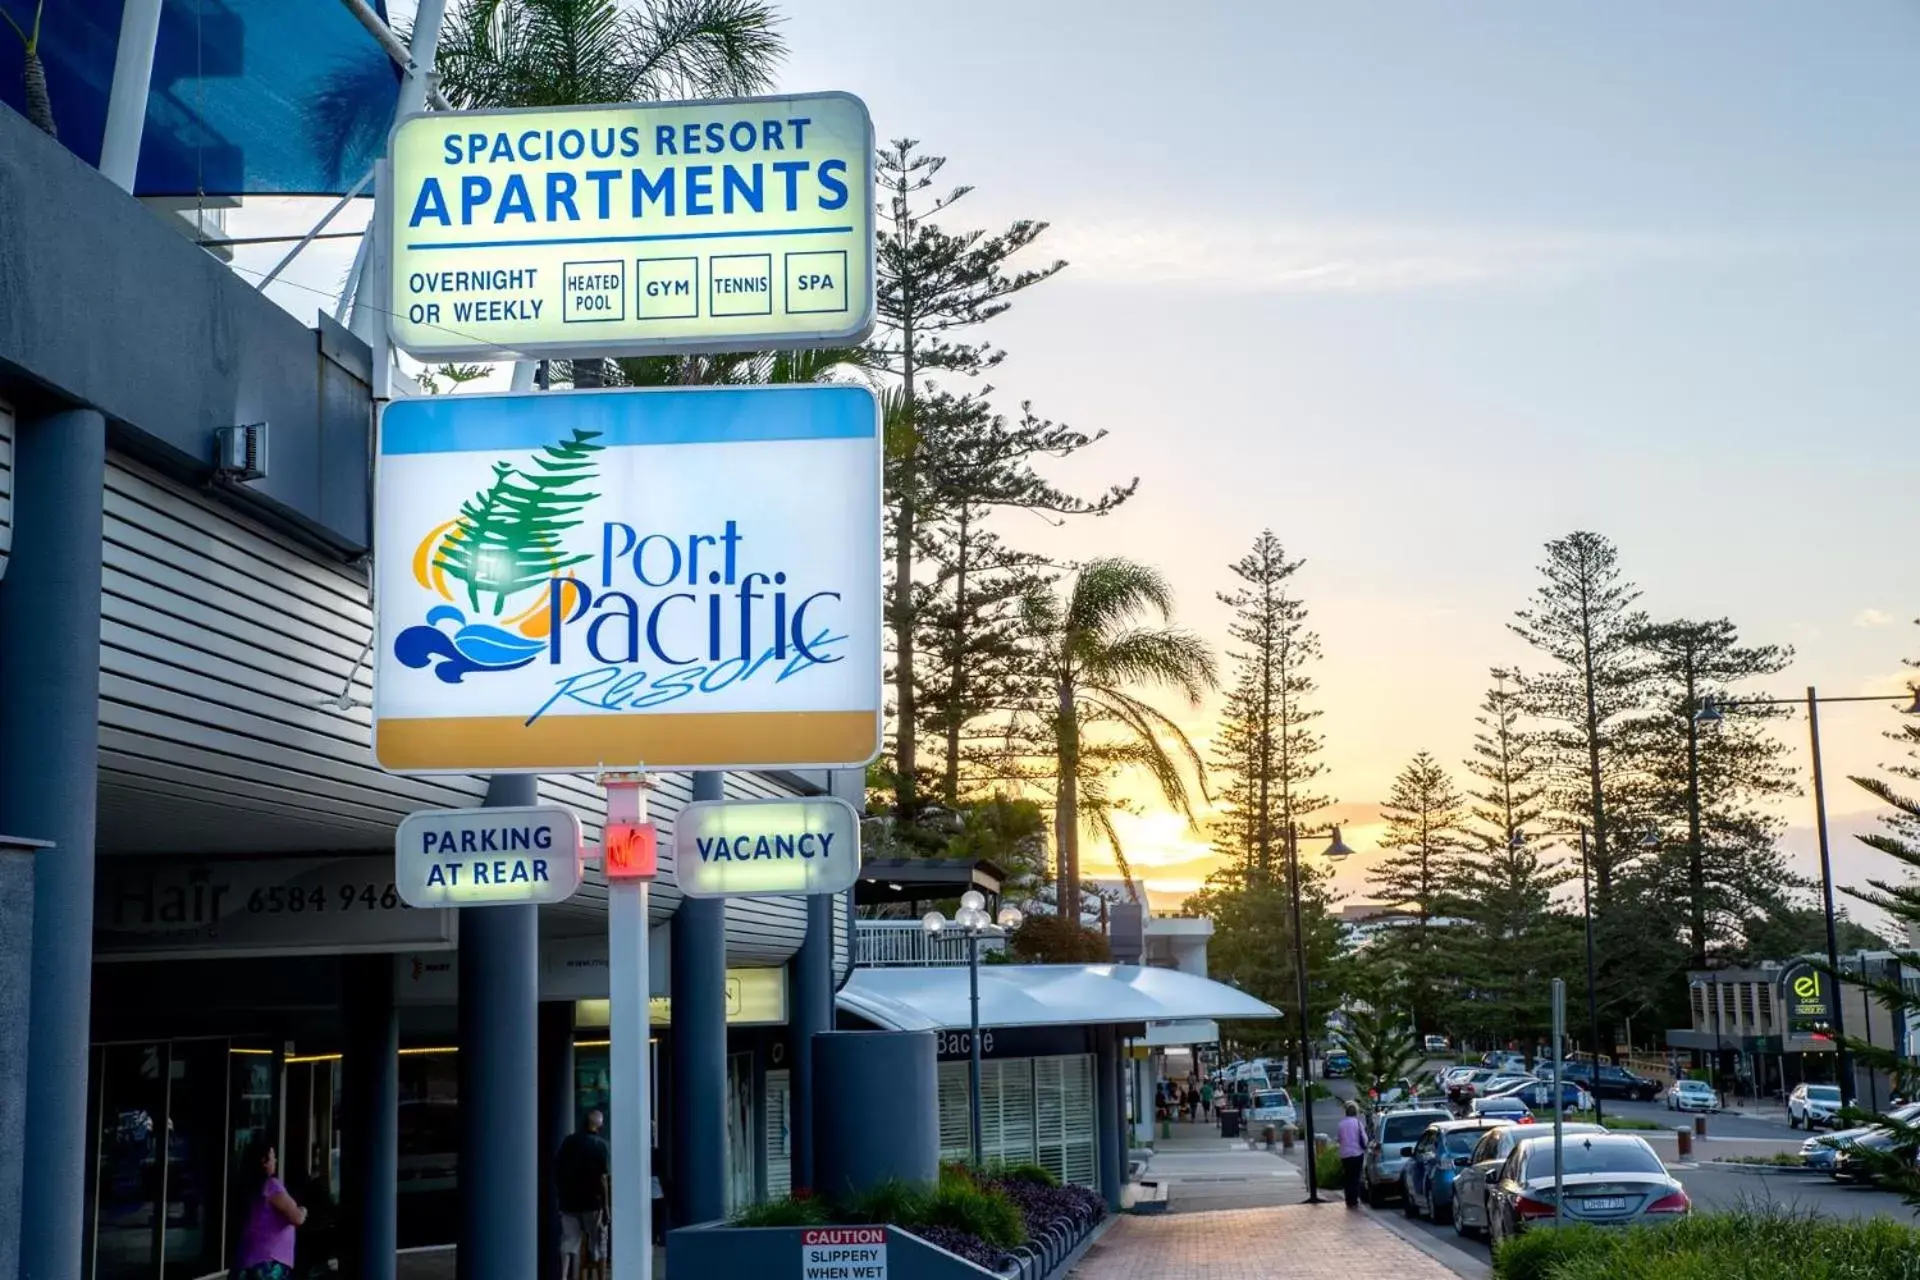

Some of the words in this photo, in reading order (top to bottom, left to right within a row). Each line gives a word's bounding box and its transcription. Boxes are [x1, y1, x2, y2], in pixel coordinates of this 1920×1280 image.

[444, 126, 640, 165] SPACIOUS
[656, 118, 811, 156] RESORT
[408, 158, 849, 228] APARTMENTS
[409, 268, 538, 295] OVERNIGHT
[568, 274, 619, 292] HEATED
[646, 279, 689, 297] GYM
[714, 276, 768, 293] TENNIS
[798, 273, 834, 291] SPA
[409, 303, 440, 325] OR
[454, 299, 543, 322] WEEKLY
[576, 295, 612, 311] POOL
[602, 520, 743, 587] Port
[550, 572, 845, 665] Pacific
[524, 628, 849, 727] Resort
[422, 826, 553, 854] PARKING
[696, 832, 835, 862] VACANCY
[427, 863, 462, 887] AT
[473, 859, 550, 884] REAR
[113, 868, 230, 924] Hair
[247, 885, 327, 914] 6584
[1794, 970, 1820, 997] el
[806, 1230, 883, 1244] CAUTION
[811, 1250, 878, 1263] SLIPPERY
[807, 1267, 848, 1279] WHEN
[853, 1266, 884, 1278] WET
